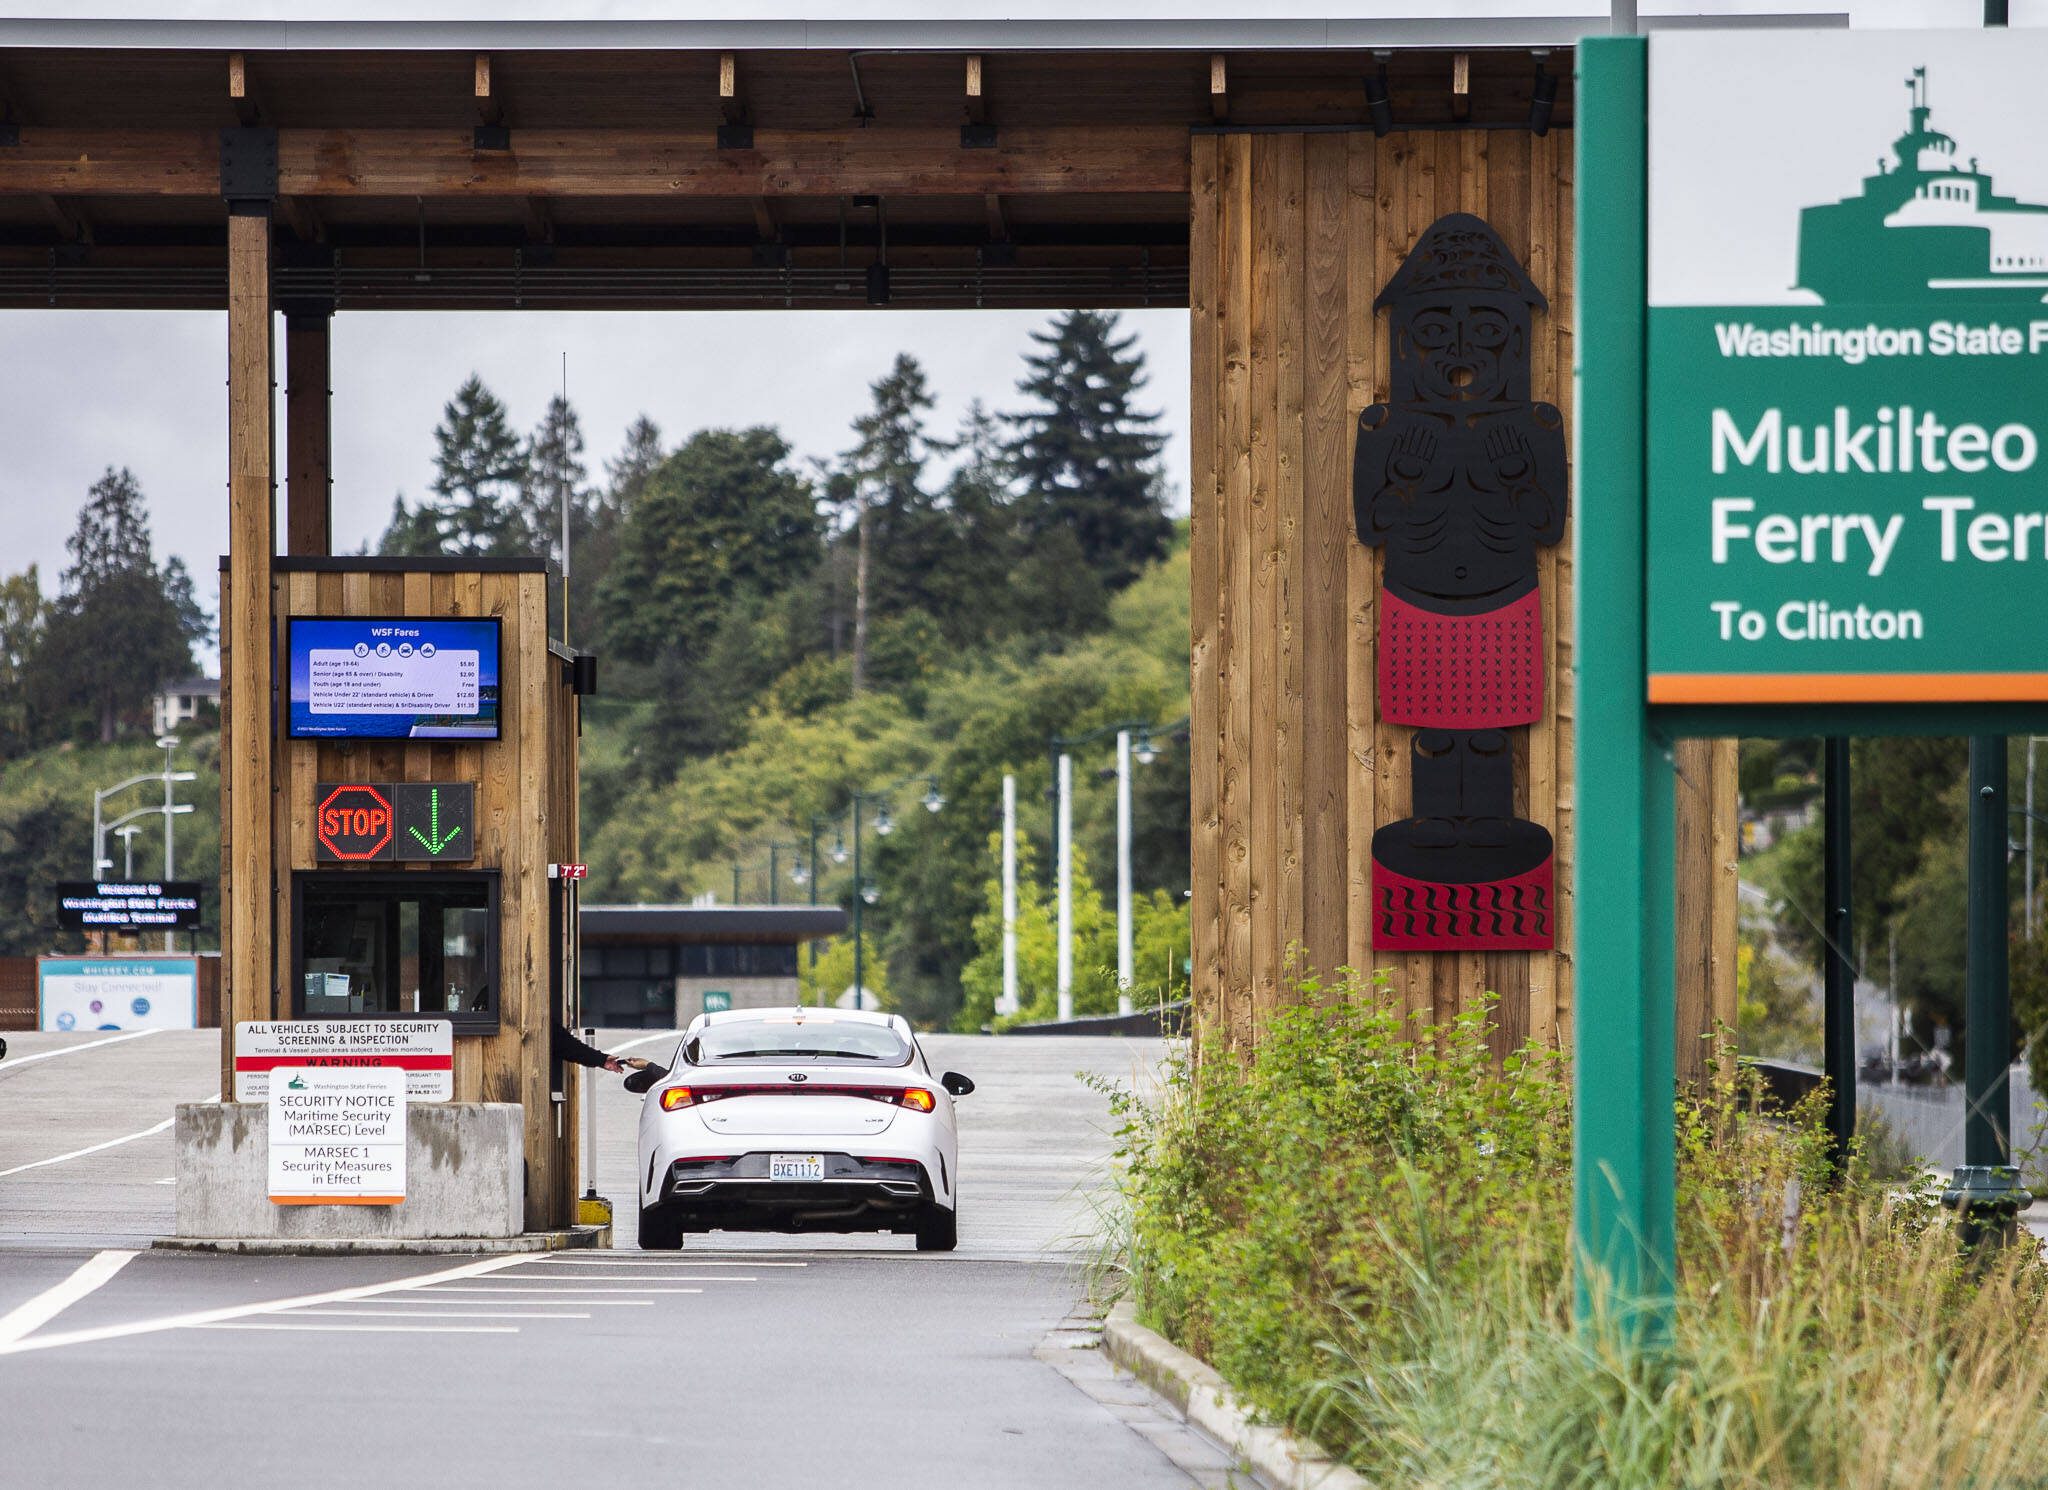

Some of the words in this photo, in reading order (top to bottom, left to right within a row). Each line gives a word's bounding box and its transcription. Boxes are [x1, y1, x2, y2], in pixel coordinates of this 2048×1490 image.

[1714, 320, 1924, 364] Washington
[1928, 320, 2023, 356] State
[1711, 405, 2038, 475] Mukilteo
[1711, 497, 1905, 577] Ferry
[1922, 496, 2048, 563] Ter
[1710, 600, 1767, 642] To
[1775, 599, 1924, 642] Clinton
[372, 628, 392, 637] WSF
[394, 628, 420, 637] Fares
[324, 808, 386, 836] STOP
[63, 898, 127, 911] Washington
[128, 898, 156, 909] State
[130, 912, 177, 924] Terminal
[248, 1025, 267, 1034] ALL
[271, 1025, 319, 1034] VEHICLES
[326, 1024, 371, 1033] SUBJECT
[375, 1024, 386, 1033] TO
[390, 1024, 439, 1033] SECURITY
[278, 1036, 335, 1045] SCREENING
[339, 1036, 345, 1044] &
[350, 1036, 409, 1044] INSPECTION
[306, 1058, 382, 1066] WARNING
[280, 1096, 342, 1107] SECURITY
[346, 1096, 395, 1106] NOTICE
[284, 1110, 338, 1121] Maritime
[342, 1111, 390, 1123] Security
[289, 1124, 350, 1136] (MARSEC)
[355, 1125, 385, 1135] Level
[304, 1147, 359, 1158] MARSEC
[364, 1148, 369, 1158] 1
[282, 1160, 331, 1173] Security
[335, 1161, 392, 1171] Measures
[312, 1174, 323, 1184] in
[328, 1174, 361, 1184] Effect
